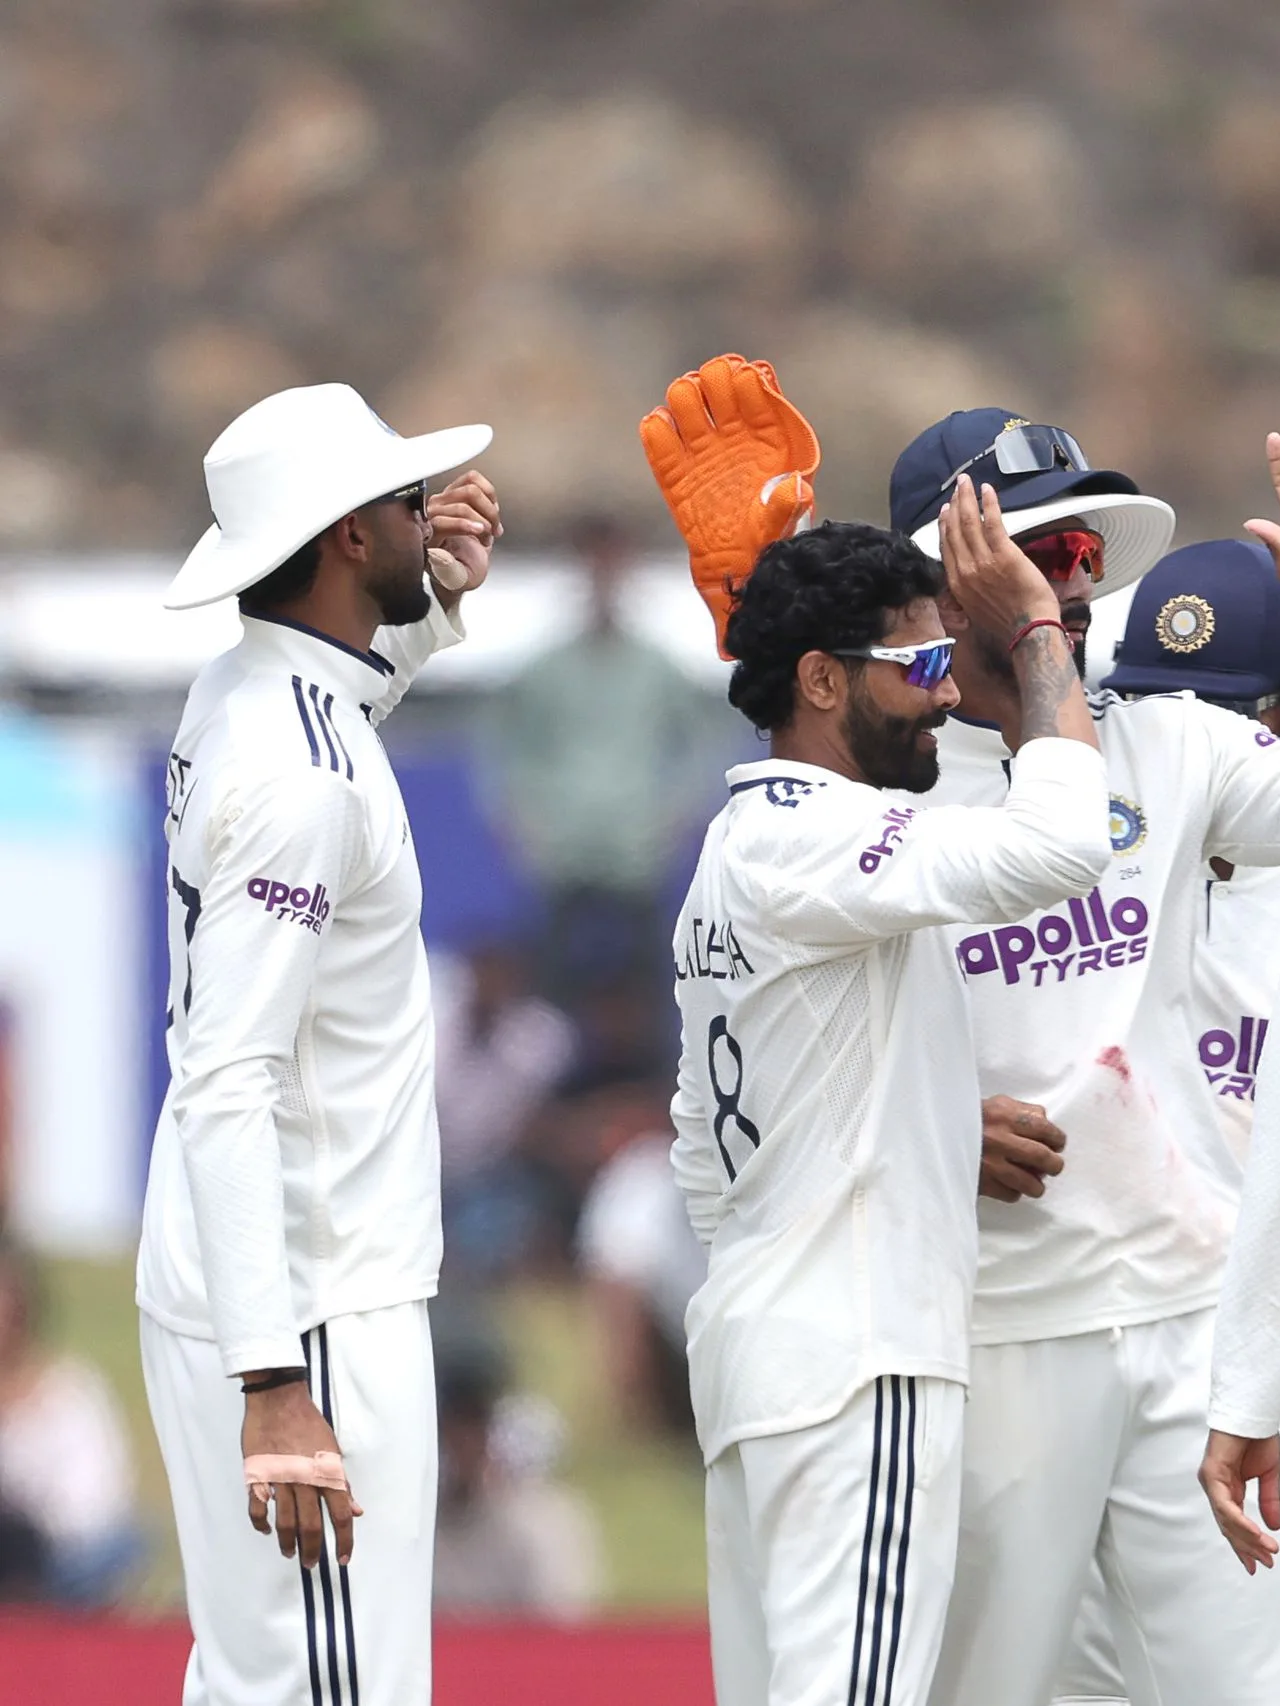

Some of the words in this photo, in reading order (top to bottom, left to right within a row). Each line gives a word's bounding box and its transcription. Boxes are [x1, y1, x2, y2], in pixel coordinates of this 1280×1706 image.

[247, 877, 330, 922] apollo
[956, 886, 1148, 985] apollo
[1030, 936, 1149, 987] TYRES
